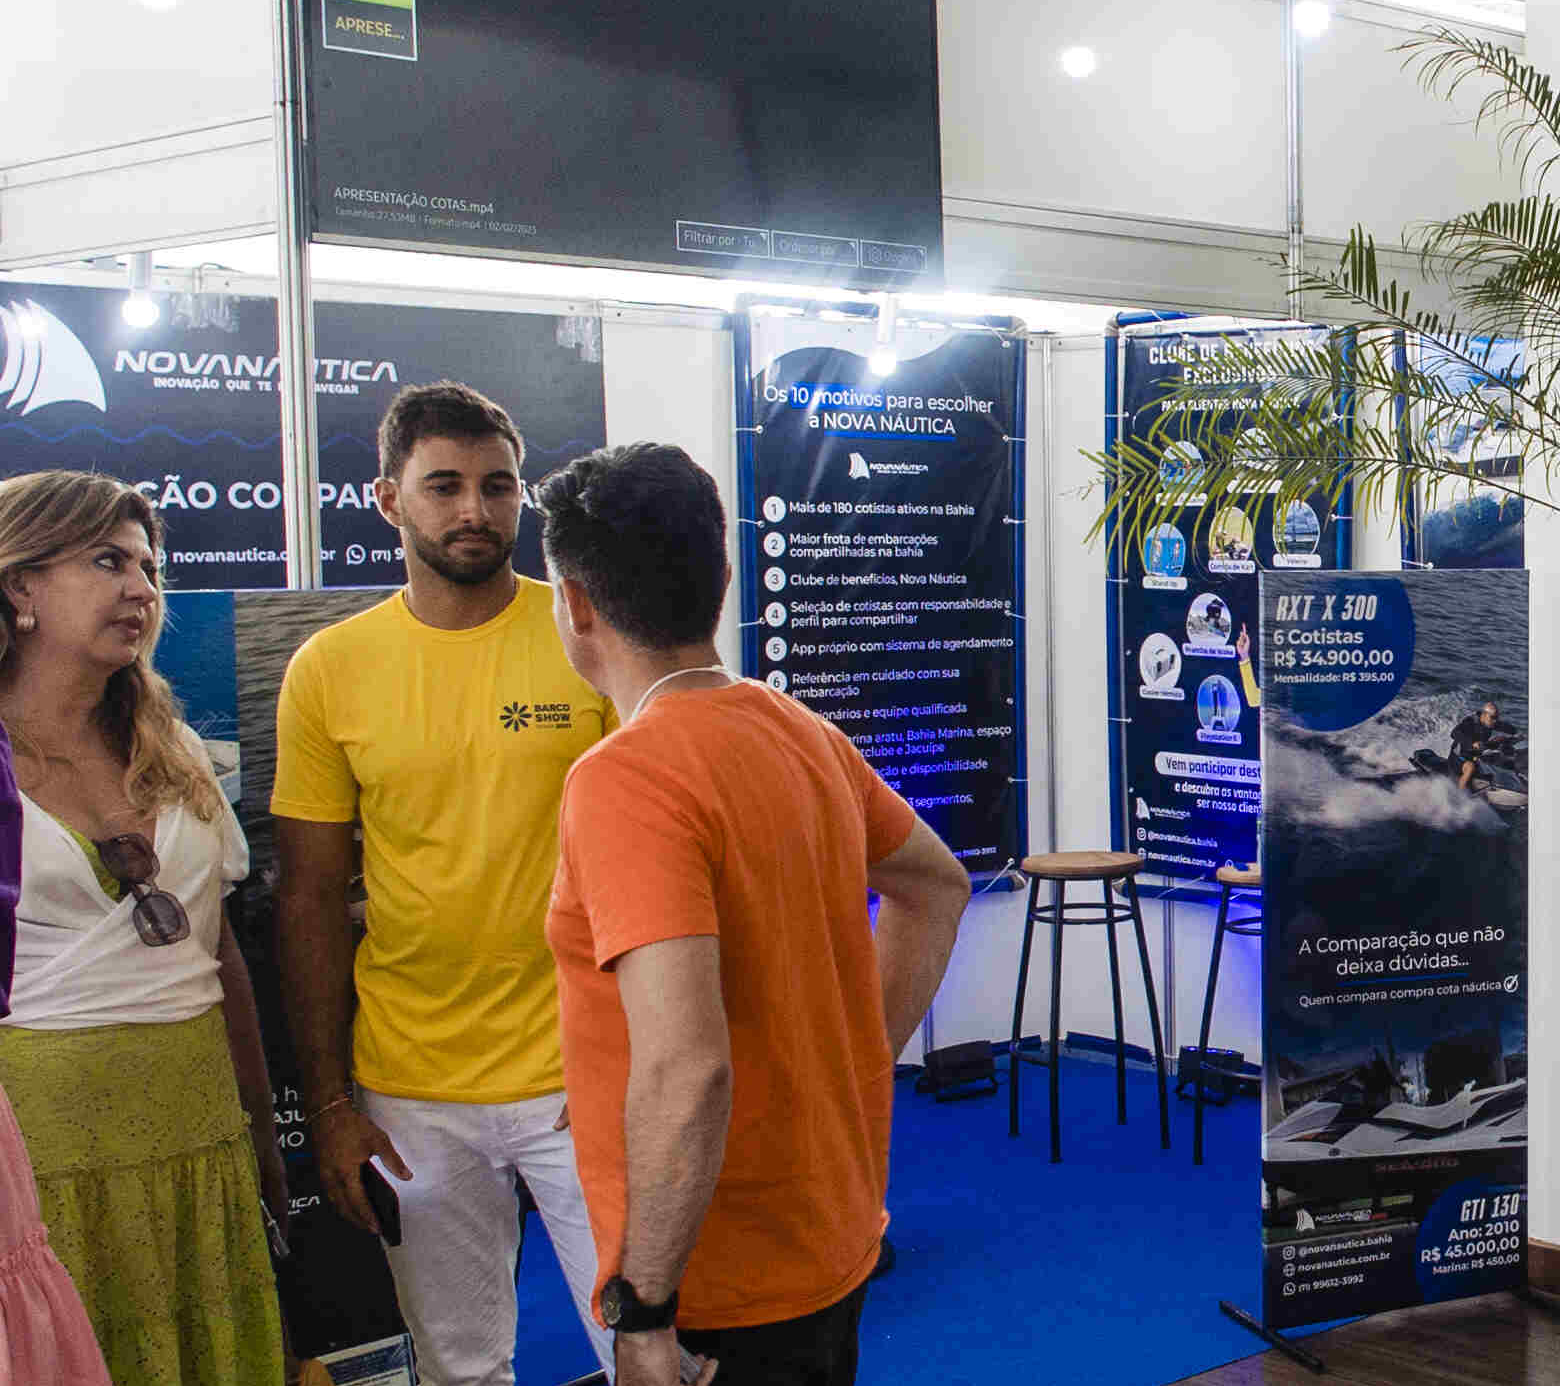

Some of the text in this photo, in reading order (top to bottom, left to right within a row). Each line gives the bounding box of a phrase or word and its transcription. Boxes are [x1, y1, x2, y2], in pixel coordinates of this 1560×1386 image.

[334, 187, 494, 214] APRESENTAÇÃO COTAS.mp4
[114, 350, 399, 382] NOVANTICA
[153, 377, 273, 393] INOVAÇÃO QUE TE
[764, 386, 994, 414] Os 10 motivos para escolher
[809, 412, 956, 434] a NOVA NÁUTICA
[790, 502, 976, 516] Mais de 180 cotistas ativos na Bahia
[790, 533, 939, 549] Maior frota de embarcações
[790, 545, 923, 560] compartilhadas na bahia
[790, 572, 967, 586] Clube de Nova Náutica
[791, 601, 918, 616] Seleção de cotistas com
[1276, 594, 1378, 621] RXT X 300
[791, 614, 918, 629] perfil para compartilhar
[1273, 627, 1364, 645] 6 Cotistas
[791, 637, 1014, 656] App próprio com sistema de agendamento
[1274, 648, 1394, 669] R$ 34.900,00
[792, 668, 960, 685] Referência em cuidado com sua
[1273, 672, 1394, 685] Mensalidade: R$ 395,00
[792, 686, 860, 700] embarcação
[535, 713, 570, 722] SHOW
[873, 707, 909, 720] equipe
[911, 703, 967, 717] qualificada
[976, 725, 1011, 738] espaço
[909, 758, 989, 776] disponibilidade
[1166, 756, 1236, 777] Vem participar
[1182, 781, 1219, 797] descubra
[1298, 925, 1505, 955] A Comparação que não
[1336, 952, 1470, 976] deixa dúvidas...
[1299, 979, 1502, 1008] Quem compara compra cota náutica
[1461, 1193, 1520, 1222] GTI 130
[1448, 1219, 1520, 1242] Ano: 2010
[1299, 1234, 1392, 1258] @novanautica.bahia
[1421, 1236, 1520, 1263] R$ 45.000,00
[1298, 1252, 1390, 1272] novanautica.com.br
[1432, 1263, 1468, 1275] Marina:
[1471, 1258, 1485, 1270] R$
